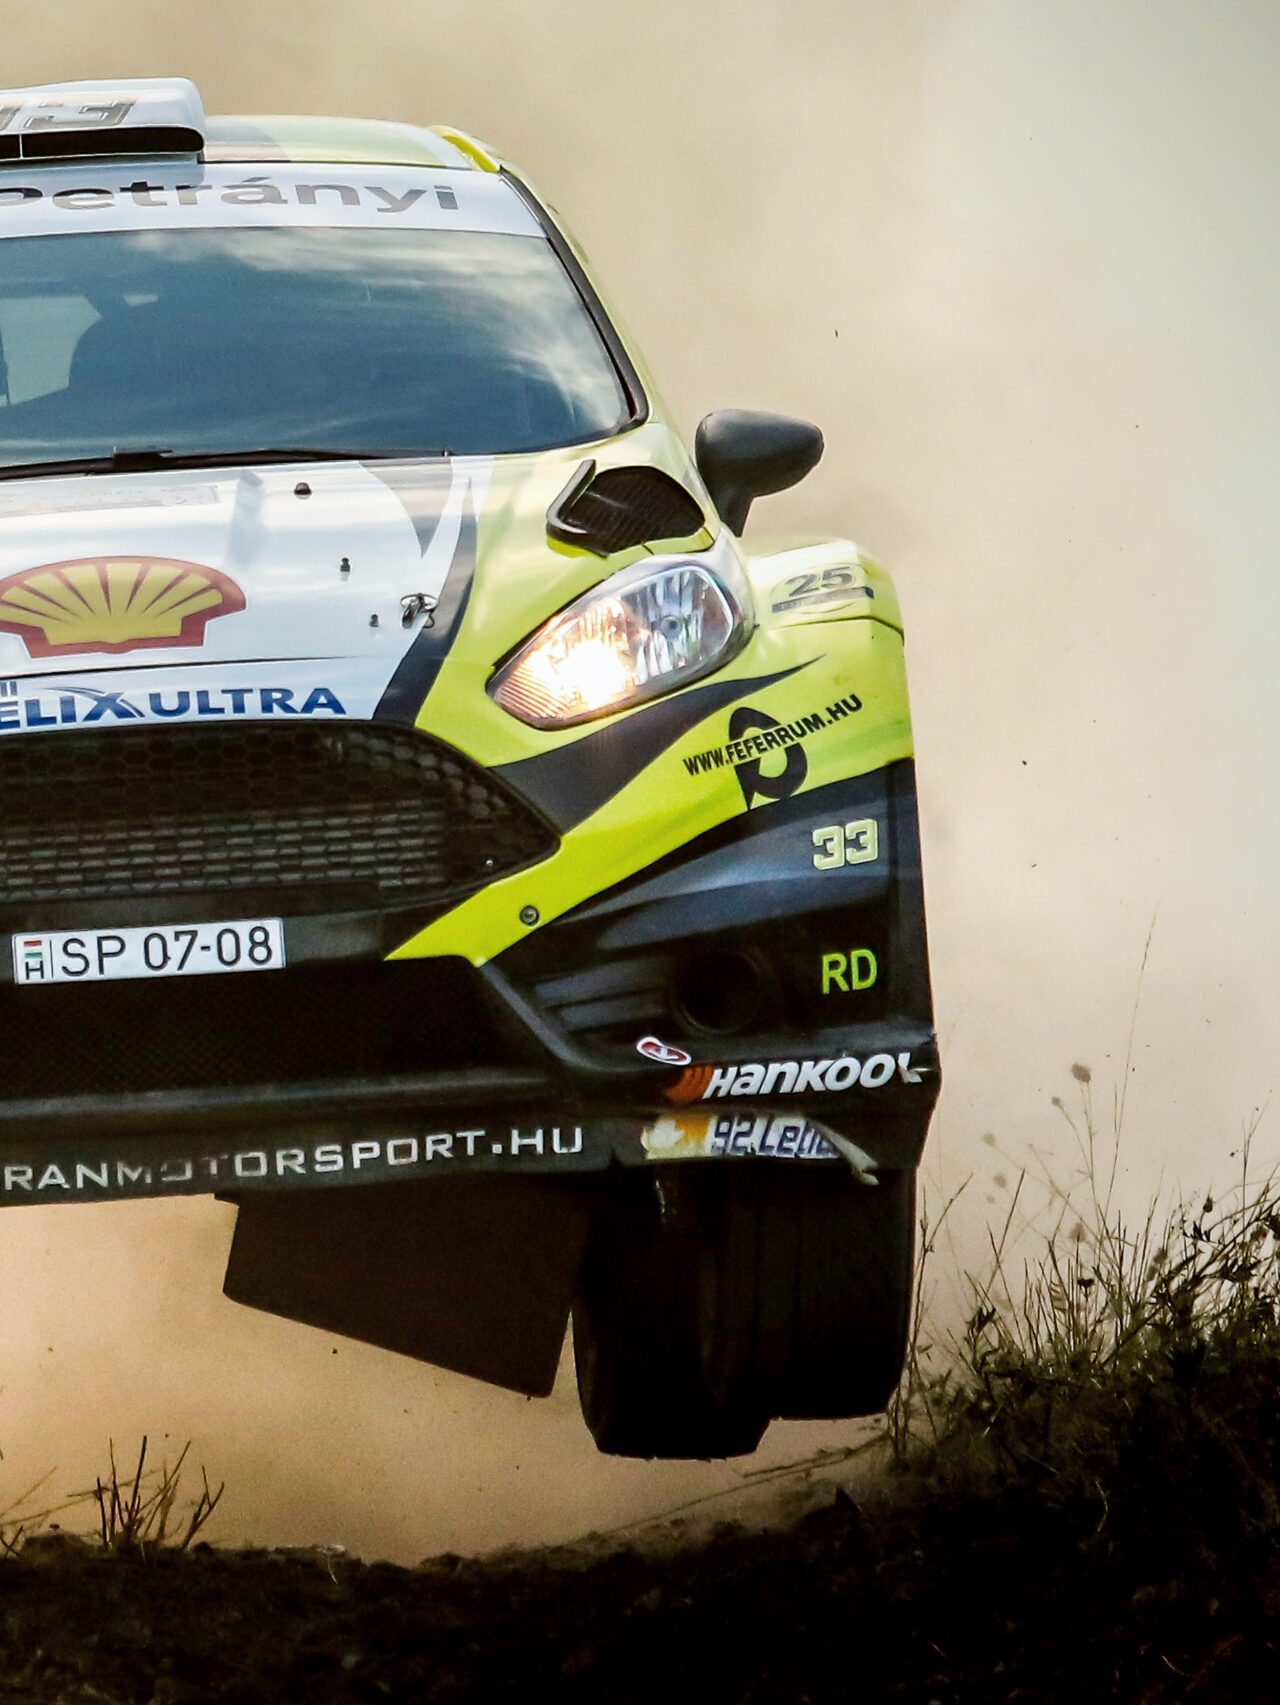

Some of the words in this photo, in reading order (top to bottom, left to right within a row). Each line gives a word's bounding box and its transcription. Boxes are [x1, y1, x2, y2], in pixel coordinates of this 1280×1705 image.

[149, 687, 347, 717] ULTRA
[683, 694, 863, 776] WWW.FEFERRUM.HU
[811, 818, 879, 870] 33
[24, 961, 45, 980] H
[61, 935, 126, 976] SP
[143, 926, 272, 971] 07-08
[822, 949, 878, 994] RD
